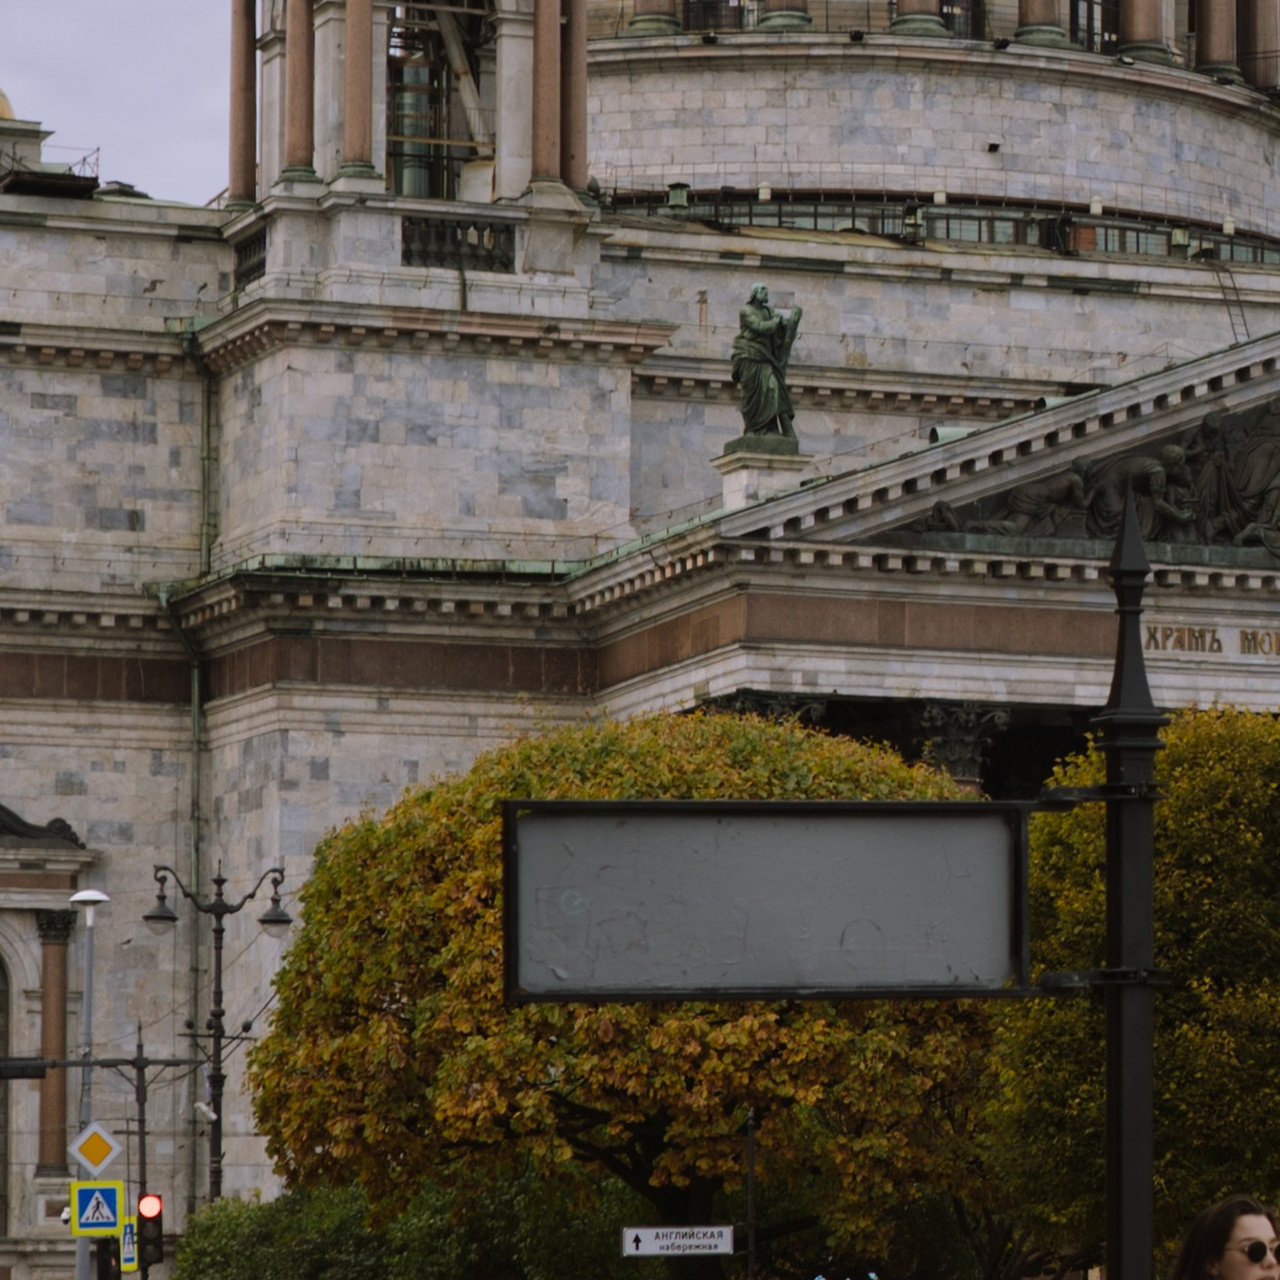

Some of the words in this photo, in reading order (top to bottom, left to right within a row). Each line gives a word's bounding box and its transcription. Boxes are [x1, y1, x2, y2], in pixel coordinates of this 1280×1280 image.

[1144, 625, 1223, 653] ХРАМЪ
[654, 1229, 724, 1241] АНГЛИЙСКАЯ
[659, 1242, 718, 1252] набережная
